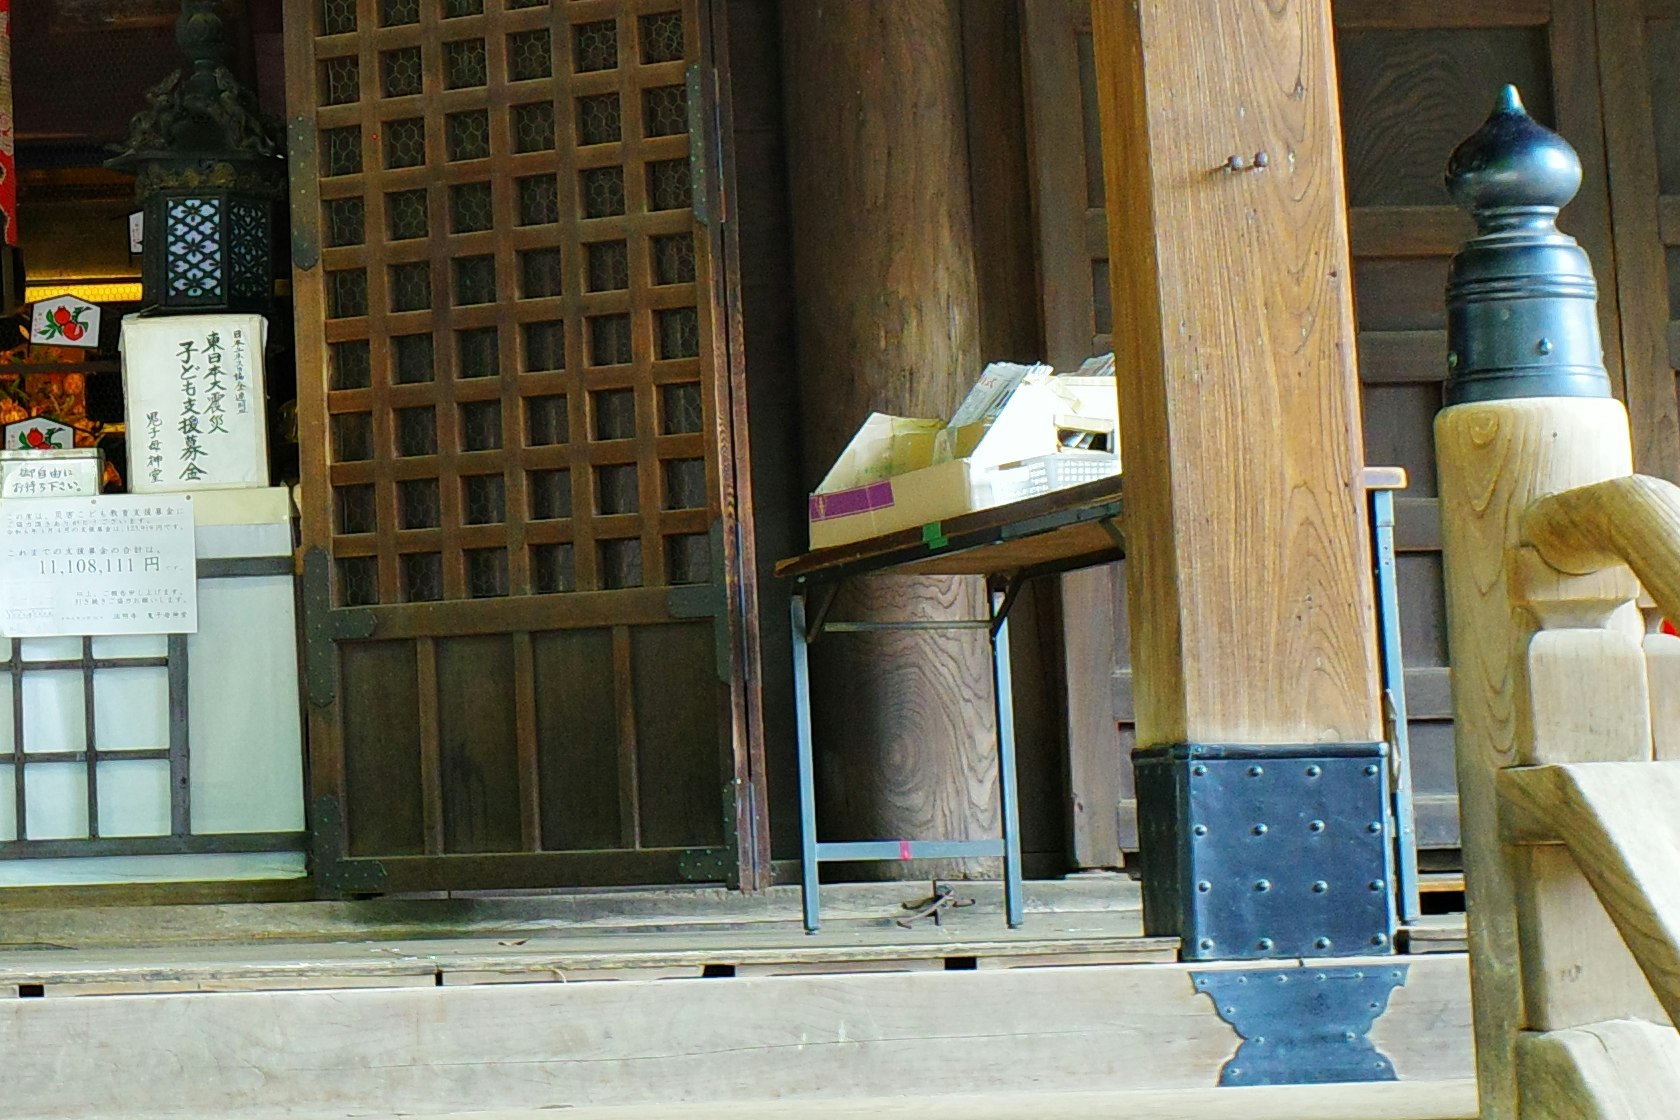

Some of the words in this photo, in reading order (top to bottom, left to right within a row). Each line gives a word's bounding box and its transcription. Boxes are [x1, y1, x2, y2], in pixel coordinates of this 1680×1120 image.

[176, 340, 209, 481] 子ども支援募金
[202, 331, 229, 434] 東日本大震災
[20, 466, 73, 479] 御自由に
[39, 558, 135, 575] 11,108,111
[144, 556, 160, 572] 円
